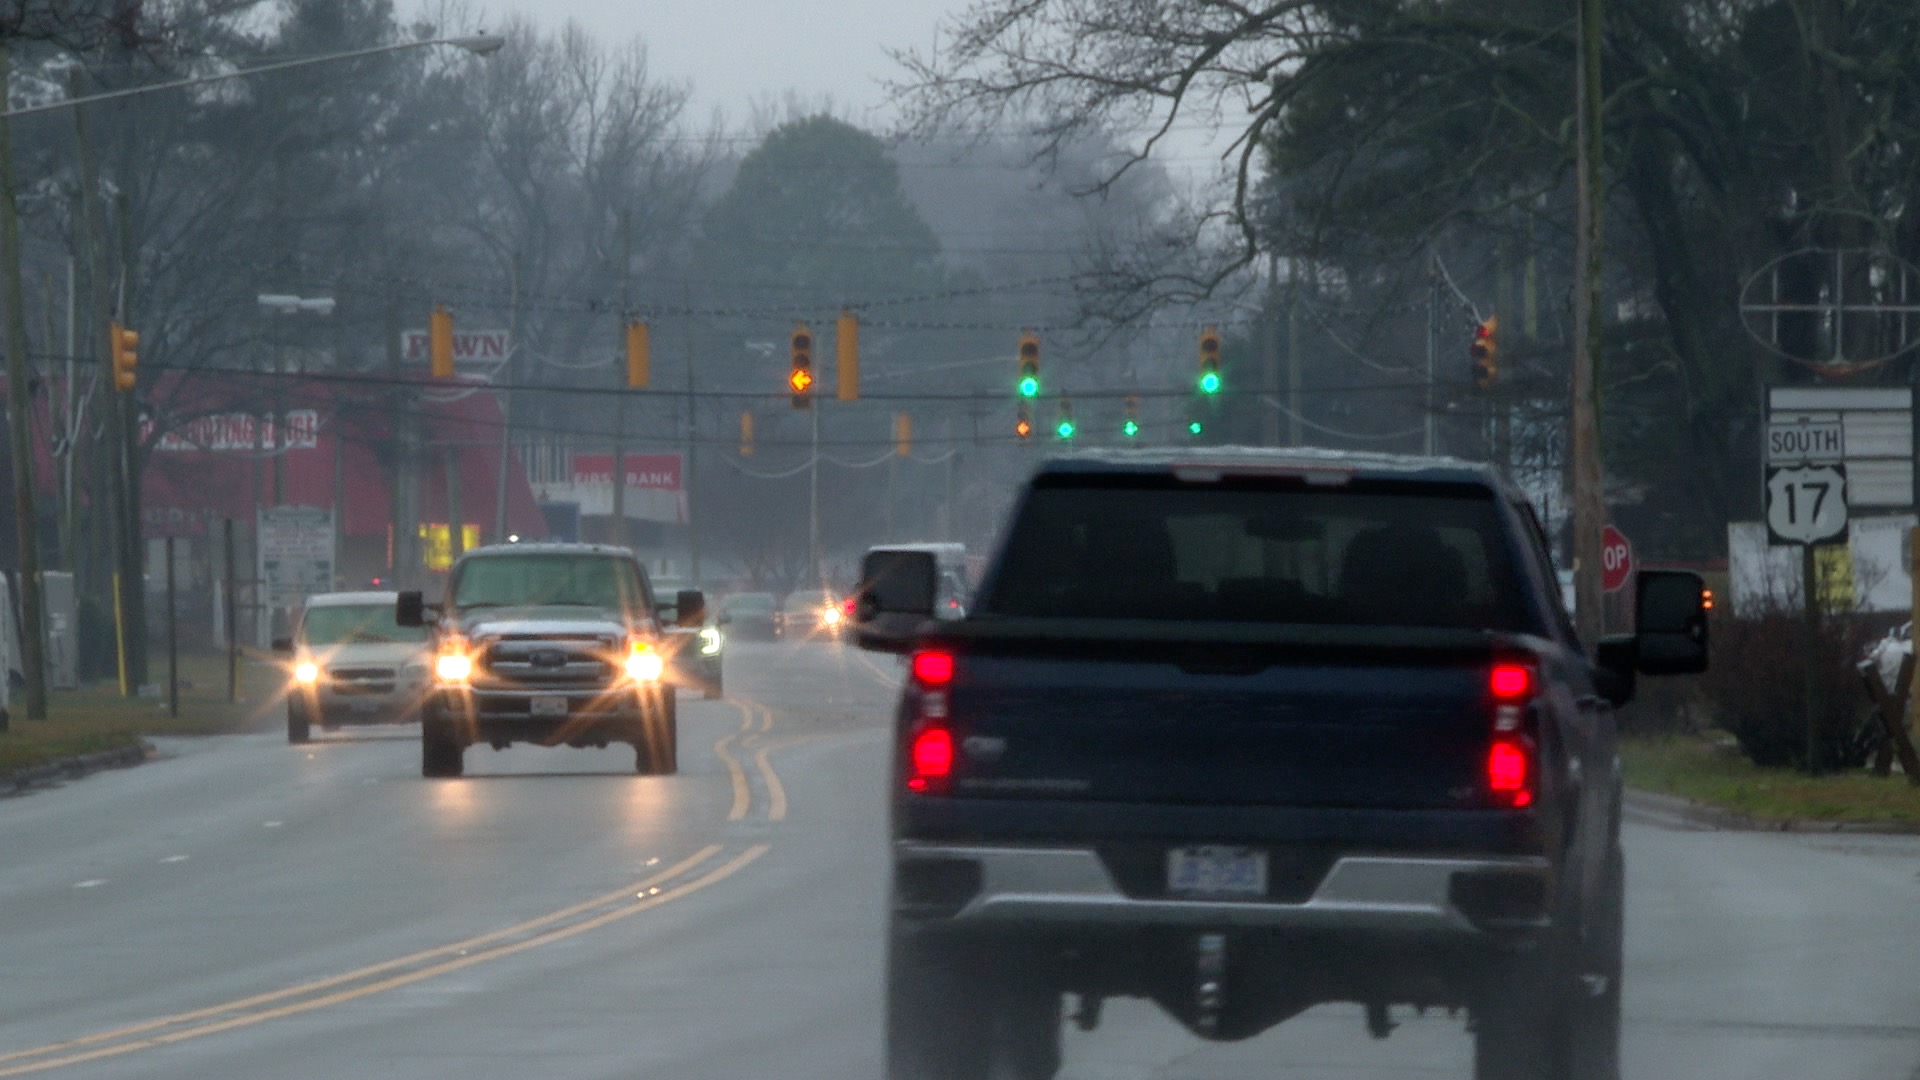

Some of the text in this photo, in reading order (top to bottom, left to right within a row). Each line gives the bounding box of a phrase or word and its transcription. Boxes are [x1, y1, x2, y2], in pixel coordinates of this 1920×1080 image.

[406, 335, 506, 357] PWN
[1771, 429, 1839, 453] SOUTH
[574, 471, 674, 485] FIRS BANK
[1784, 482, 1830, 525] 17
[1604, 544, 1628, 571] OP
